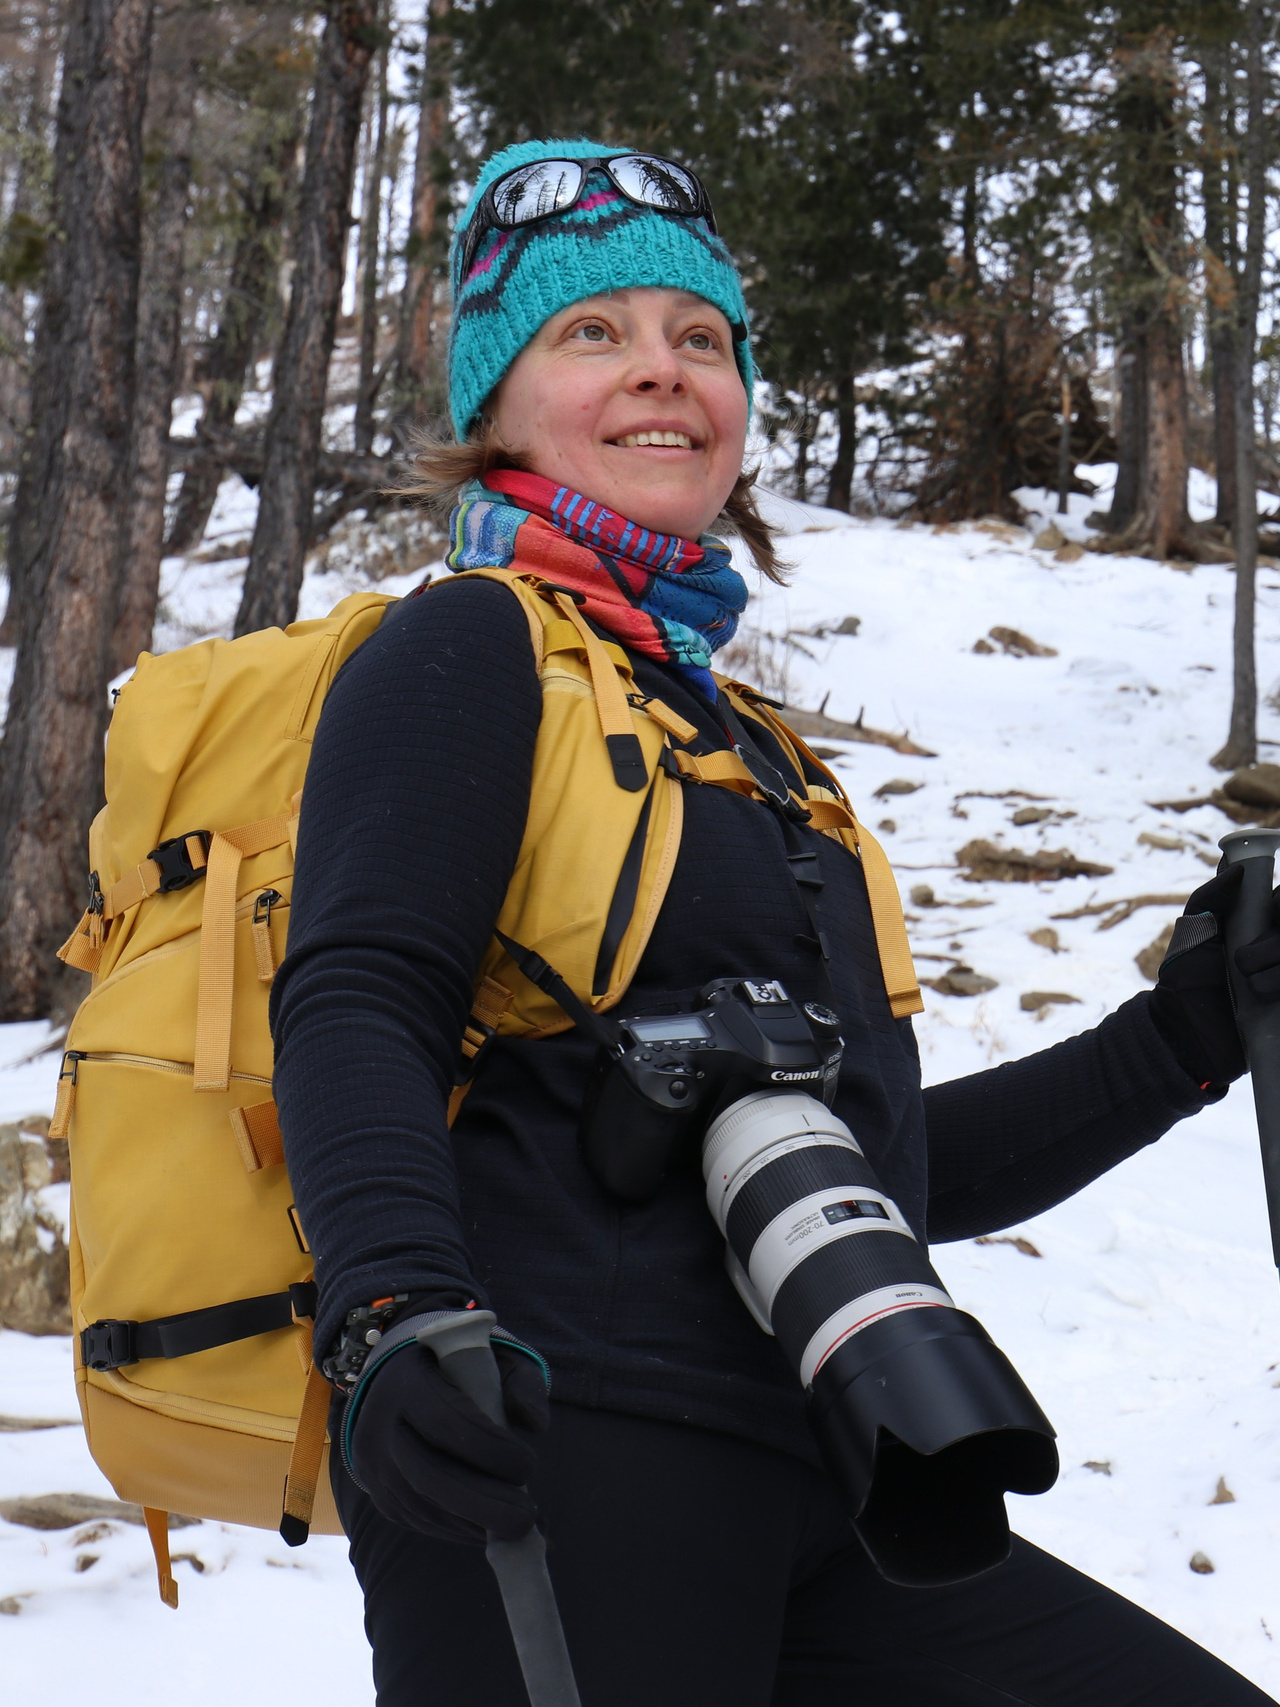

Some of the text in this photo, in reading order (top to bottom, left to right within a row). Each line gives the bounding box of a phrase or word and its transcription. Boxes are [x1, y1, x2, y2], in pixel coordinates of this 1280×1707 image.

[770, 1069, 820, 1082] Canon
[788, 1220, 825, 1247] 70-200mm
[895, 1290, 924, 1299] Canon
